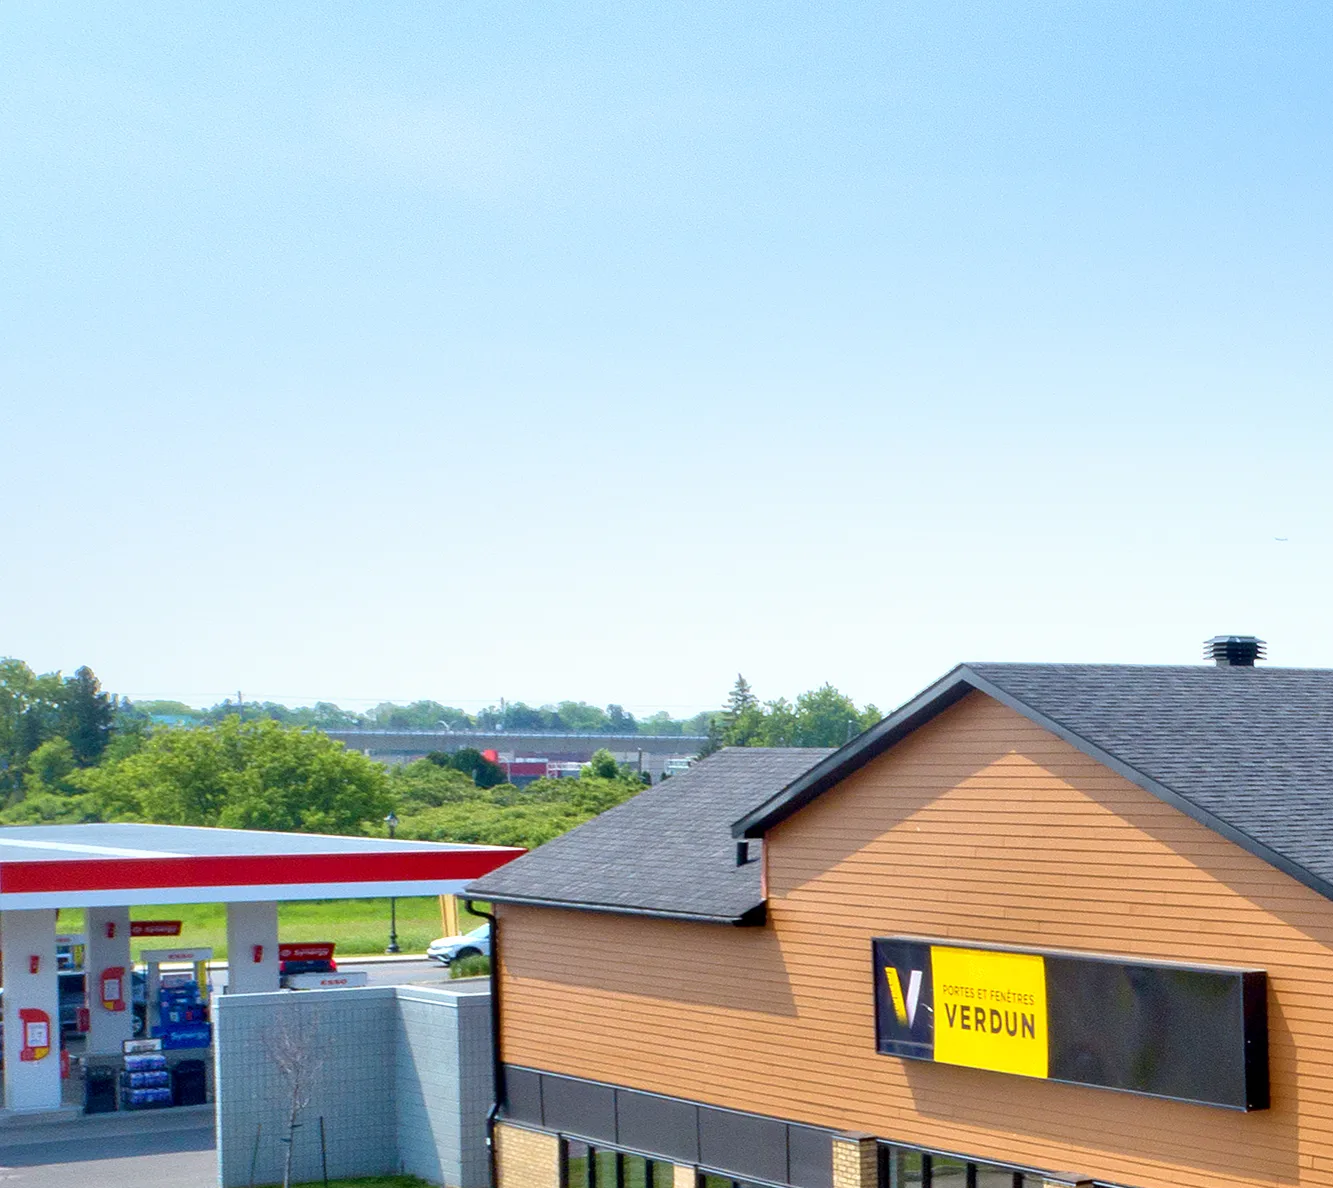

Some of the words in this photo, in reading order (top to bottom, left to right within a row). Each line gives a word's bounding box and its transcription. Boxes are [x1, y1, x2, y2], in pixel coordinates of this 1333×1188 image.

[943, 984, 975, 999] PORTES
[978, 988, 987, 1000] ET
[944, 1003, 1035, 1039] VERDUN
